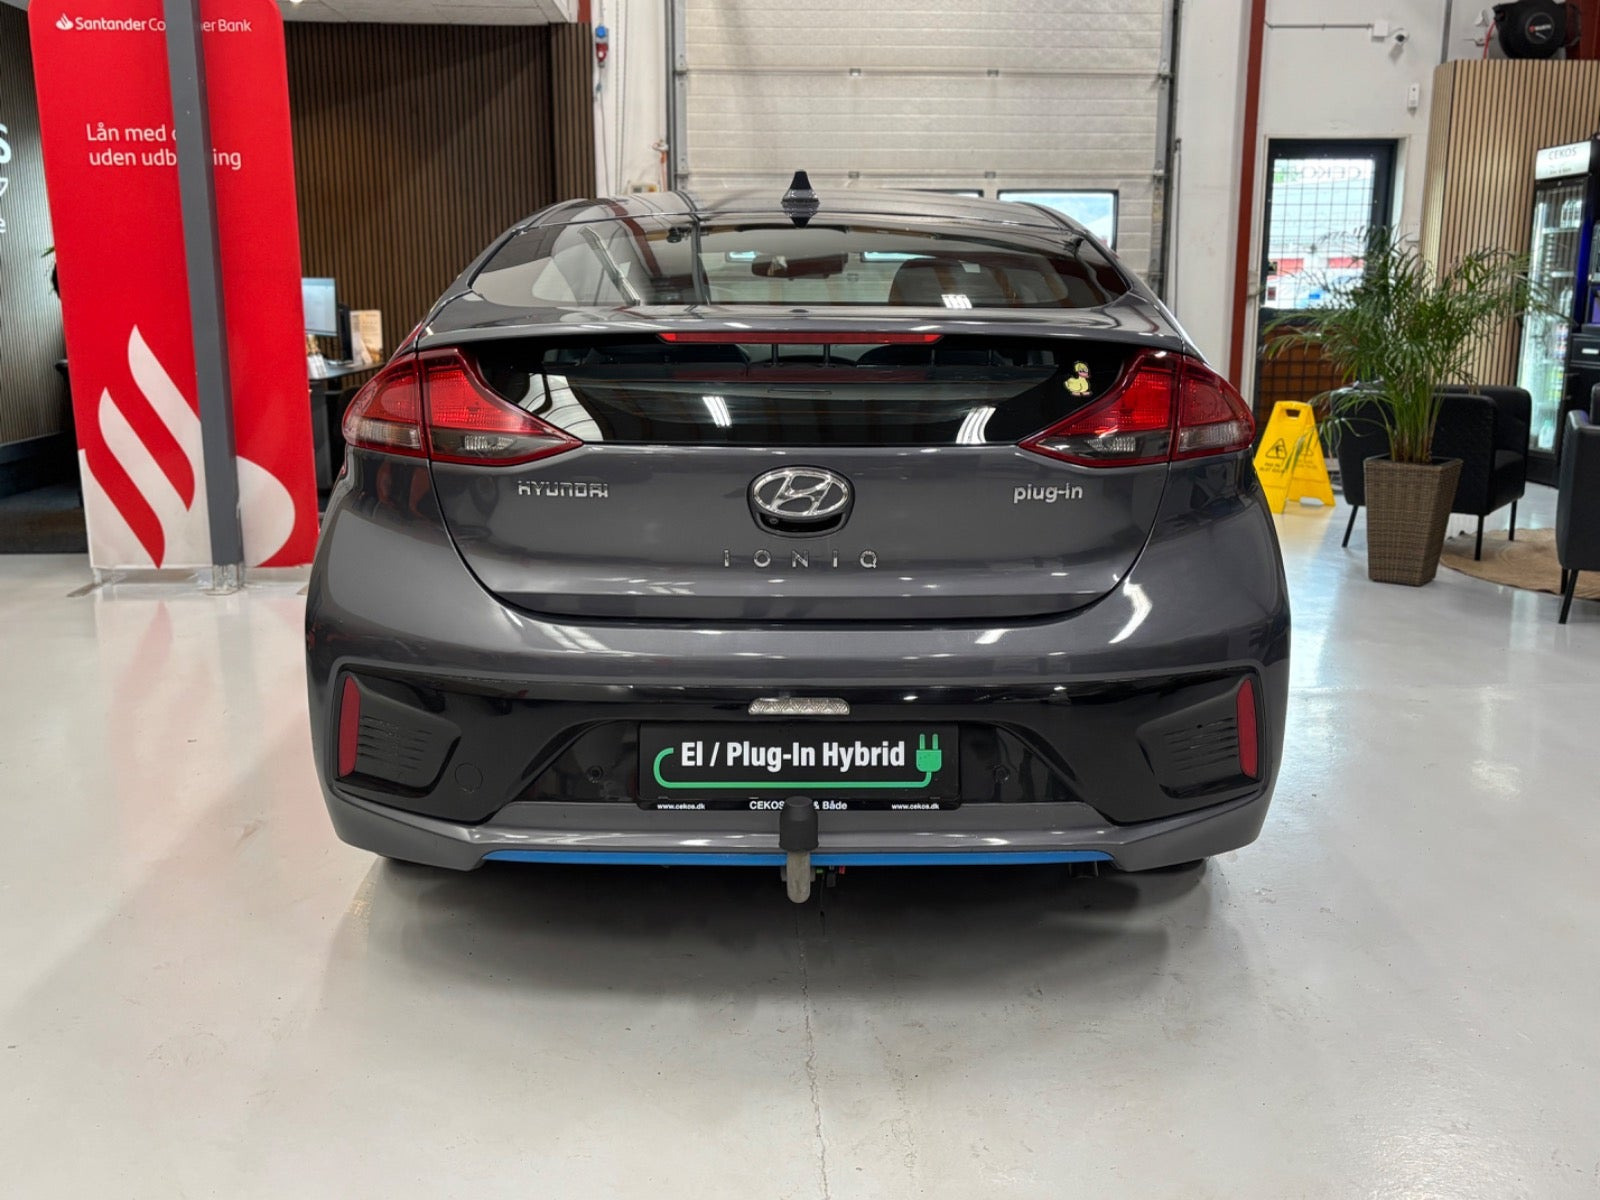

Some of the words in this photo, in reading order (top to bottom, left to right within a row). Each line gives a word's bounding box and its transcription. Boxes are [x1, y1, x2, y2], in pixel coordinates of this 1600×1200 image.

[75, 17, 146, 31] Santander
[148, 18, 215, 32] Coer
[218, 19, 252, 32] Bank
[86, 122, 119, 142] Lån
[125, 124, 167, 142] med
[89, 148, 136, 166] uden
[142, 148, 242, 170] udbing
[518, 480, 609, 498] HYUNDAI
[1013, 482, 1083, 504] plug-in
[724, 549, 877, 568] IONIQ
[681, 741, 703, 766] El
[709, 742, 720, 766] /
[726, 741, 815, 772] Plug-In
[822, 741, 905, 772] Hybrid
[749, 800, 784, 810] CEKOS
[822, 800, 848, 810] Både
